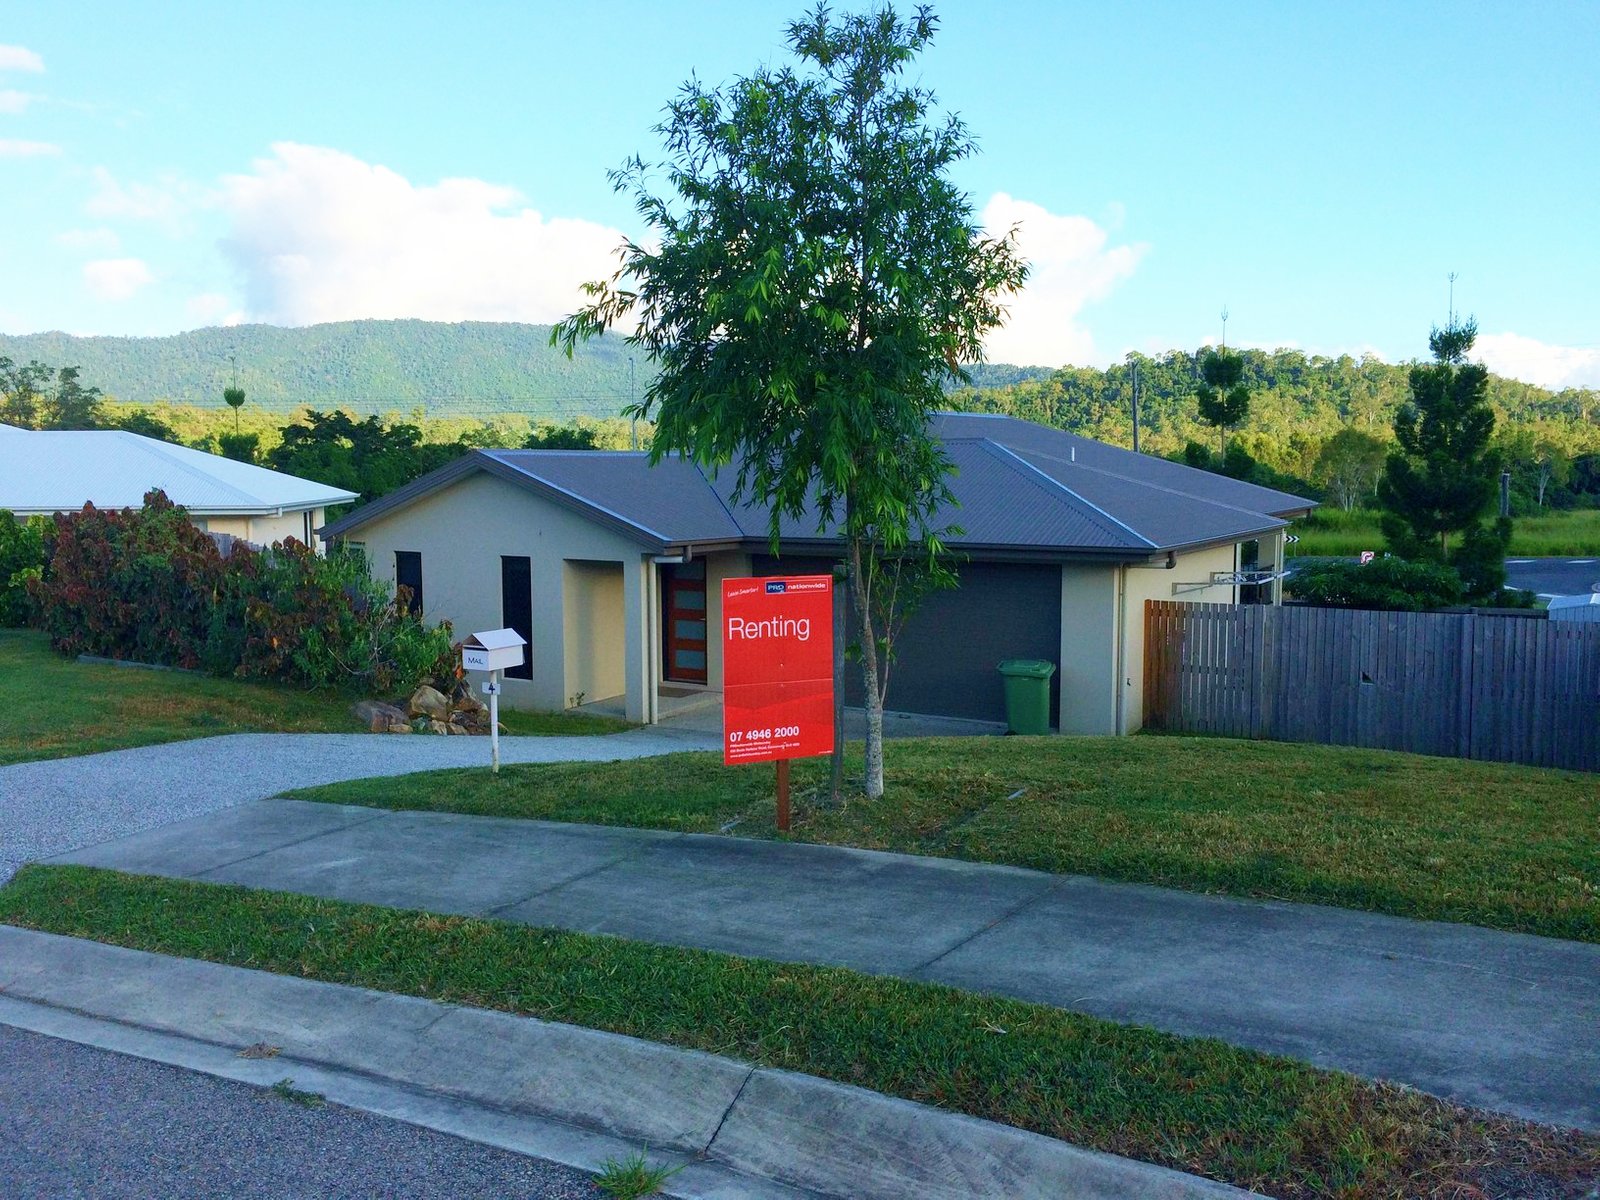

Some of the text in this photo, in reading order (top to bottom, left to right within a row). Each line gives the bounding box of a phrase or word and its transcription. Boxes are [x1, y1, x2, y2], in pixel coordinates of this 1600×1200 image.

[728, 615, 810, 641] Renting
[488, 682, 495, 695] 4
[729, 726, 800, 742] 07 4946 2000
